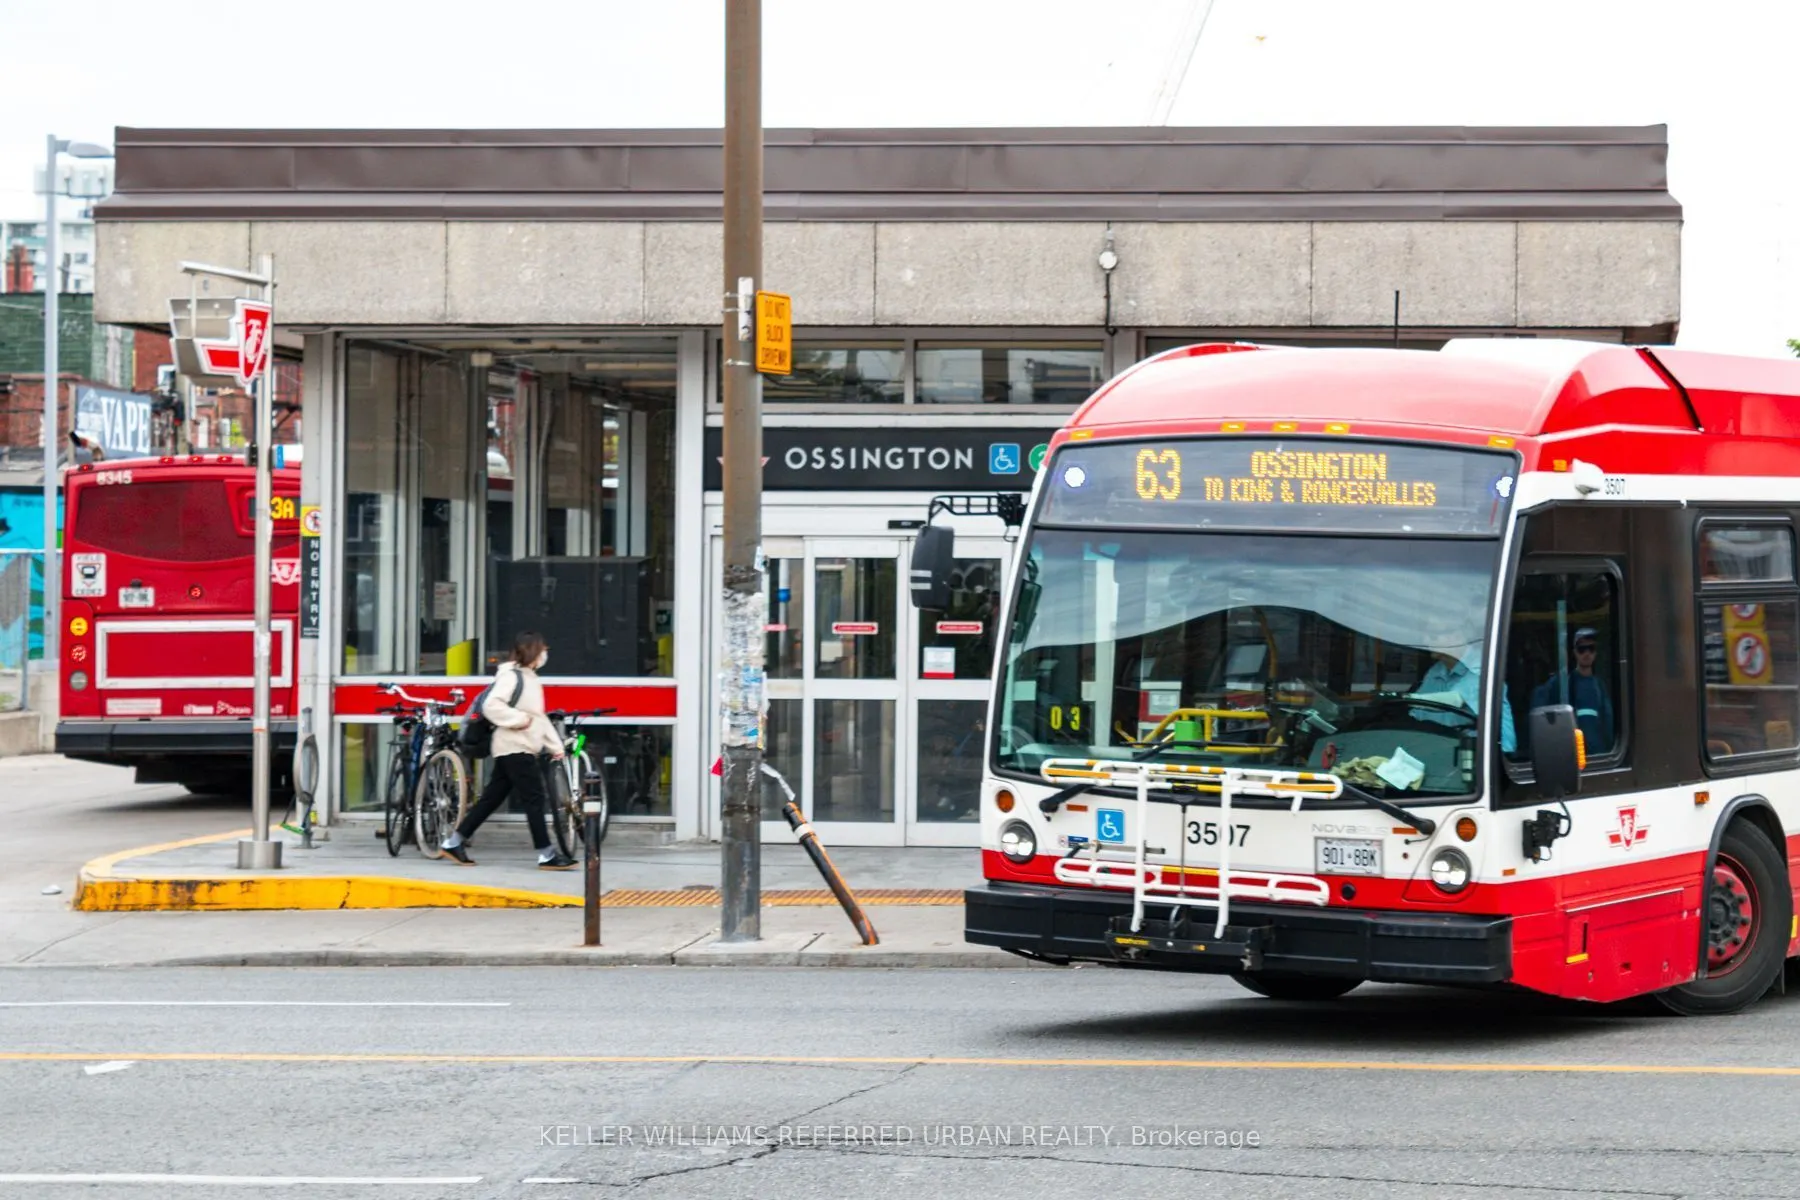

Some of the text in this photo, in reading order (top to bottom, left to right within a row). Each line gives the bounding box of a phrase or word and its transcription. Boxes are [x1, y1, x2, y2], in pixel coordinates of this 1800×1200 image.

[100, 396, 151, 453] VAPE
[785, 447, 973, 470] OSSINGTON
[1251, 451, 1387, 480] OSSINGTON
[1136, 448, 1181, 500] 63
[1604, 478, 1625, 496] 3507
[1203, 477, 1224, 501] TO
[1230, 477, 1274, 502] KING
[1280, 479, 1295, 503] &
[310, 540, 319, 561] NO
[310, 567, 319, 626] ENTRY
